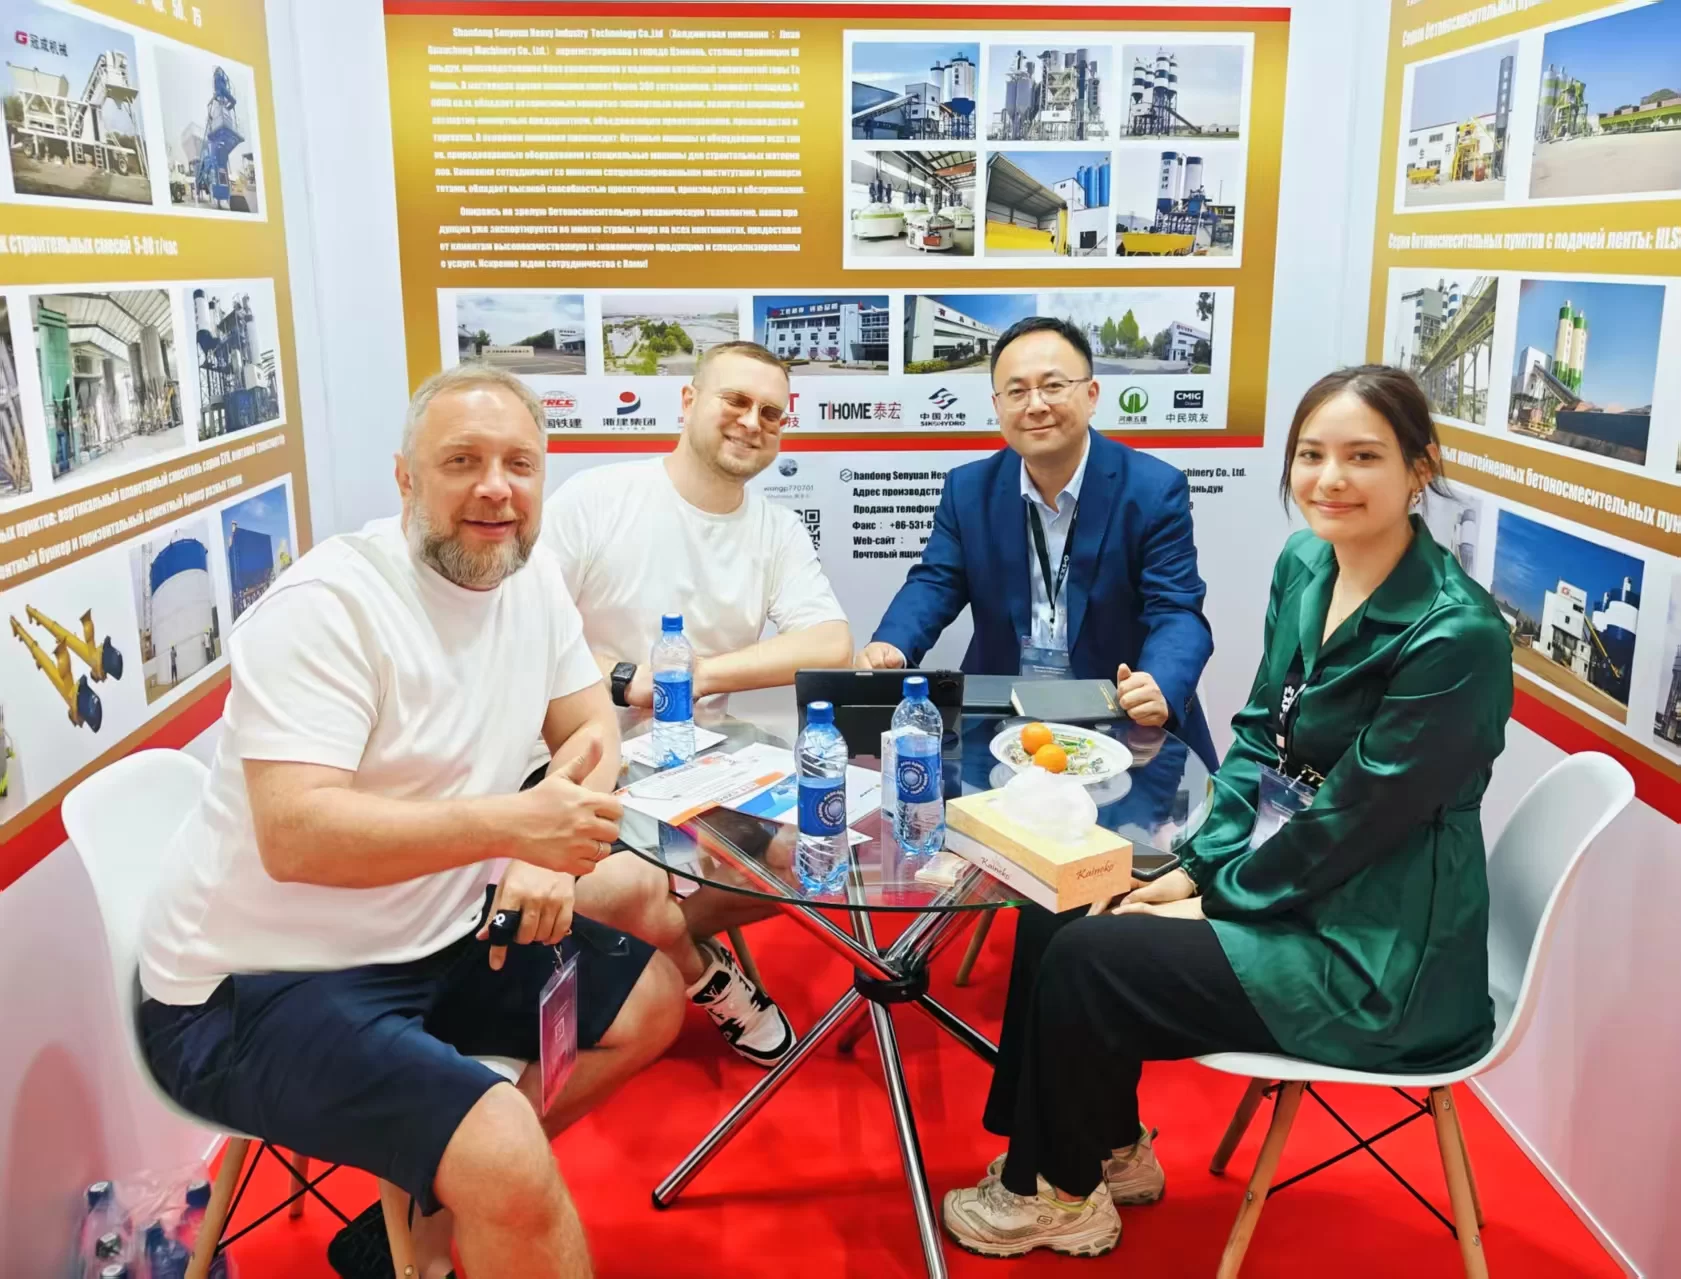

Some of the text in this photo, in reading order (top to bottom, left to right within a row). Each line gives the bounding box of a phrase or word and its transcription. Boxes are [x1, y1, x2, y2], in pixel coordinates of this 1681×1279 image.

[453, 29, 493, 38] Shandong
[529, 29, 553, 38] Heavy
[555, 29, 587, 38] Industry
[591, 29, 636, 38] Technology
[687, 151, 704, 160] для
[705, 151, 764, 160] строительных
[495, 168, 553, 177] сотрудничает
[468, 185, 508, 193] обладает
[670, 226, 691, 234] всех
[1503, 232, 1544, 252] пунктов
[1546, 233, 1553, 249] с
[1554, 227, 1605, 252] подачей
[547, 259, 615, 268] сотрудничества
[1175, 392, 1201, 401] CMIG
[873, 401, 902, 420] 泰宏
[919, 412, 967, 421] 中国水电
[1165, 412, 1209, 423] 中民筑友
[853, 471, 891, 481] handong
[892, 470, 930, 481] Senyuan
[1232, 468, 1247, 477] Ltd.
[852, 487, 881, 497] Адрес
[1457, 449, 1526, 486] контейнерных
[1525, 467, 1655, 526] бетоносмесительных
[853, 504, 895, 514] Продажа
[71, 536, 79, 552] и
[78, 508, 145, 549] горизонтальный
[144, 493, 184, 523] цементный
[852, 521, 877, 530] Факс
[852, 535, 896, 545] Web-сайт
[852, 549, 898, 559] Почтовый
[1075, 859, 1116, 880] Kaineko
